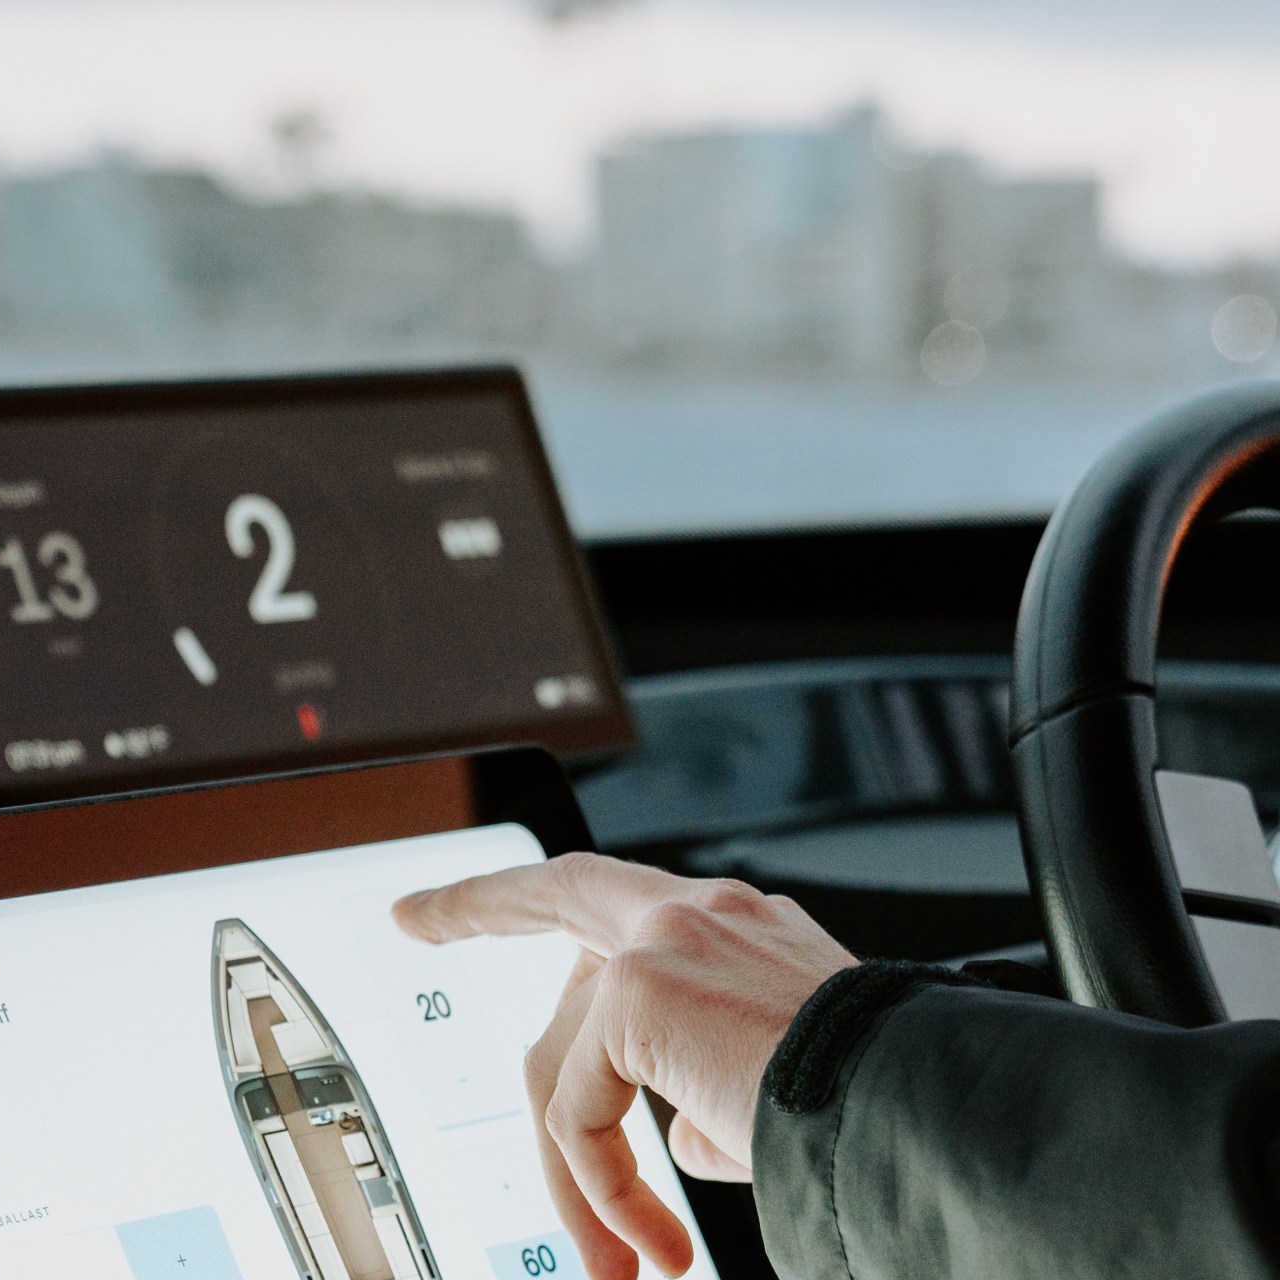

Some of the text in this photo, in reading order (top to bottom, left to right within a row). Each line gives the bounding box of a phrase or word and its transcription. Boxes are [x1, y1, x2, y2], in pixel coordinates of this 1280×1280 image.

[225, 493, 317, 624] 2
[416, 990, 452, 1022] 20
[521, 1244, 557, 1277] 60
